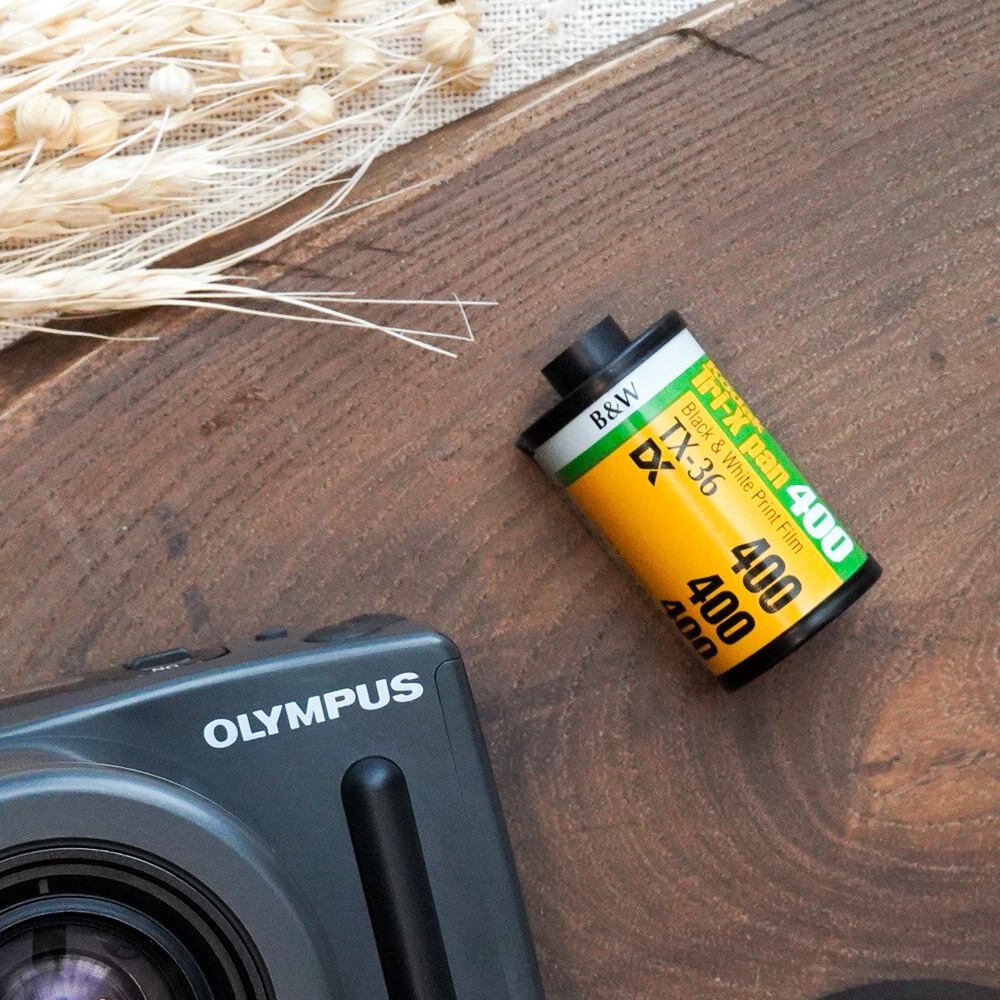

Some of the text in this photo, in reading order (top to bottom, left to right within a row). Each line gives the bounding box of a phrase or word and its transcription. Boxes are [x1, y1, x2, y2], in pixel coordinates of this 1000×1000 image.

[589, 381, 639, 430] B&W
[629, 438, 676, 487] DX
[658, 416, 726, 497] TX-36
[681, 401, 805, 555] Black & White Print Film
[690, 367, 854, 563] Tri-X pan 400
[686, 573, 756, 646] 400
[731, 537, 803, 614] 400
[203, 671, 424, 749] OLYMPUS
